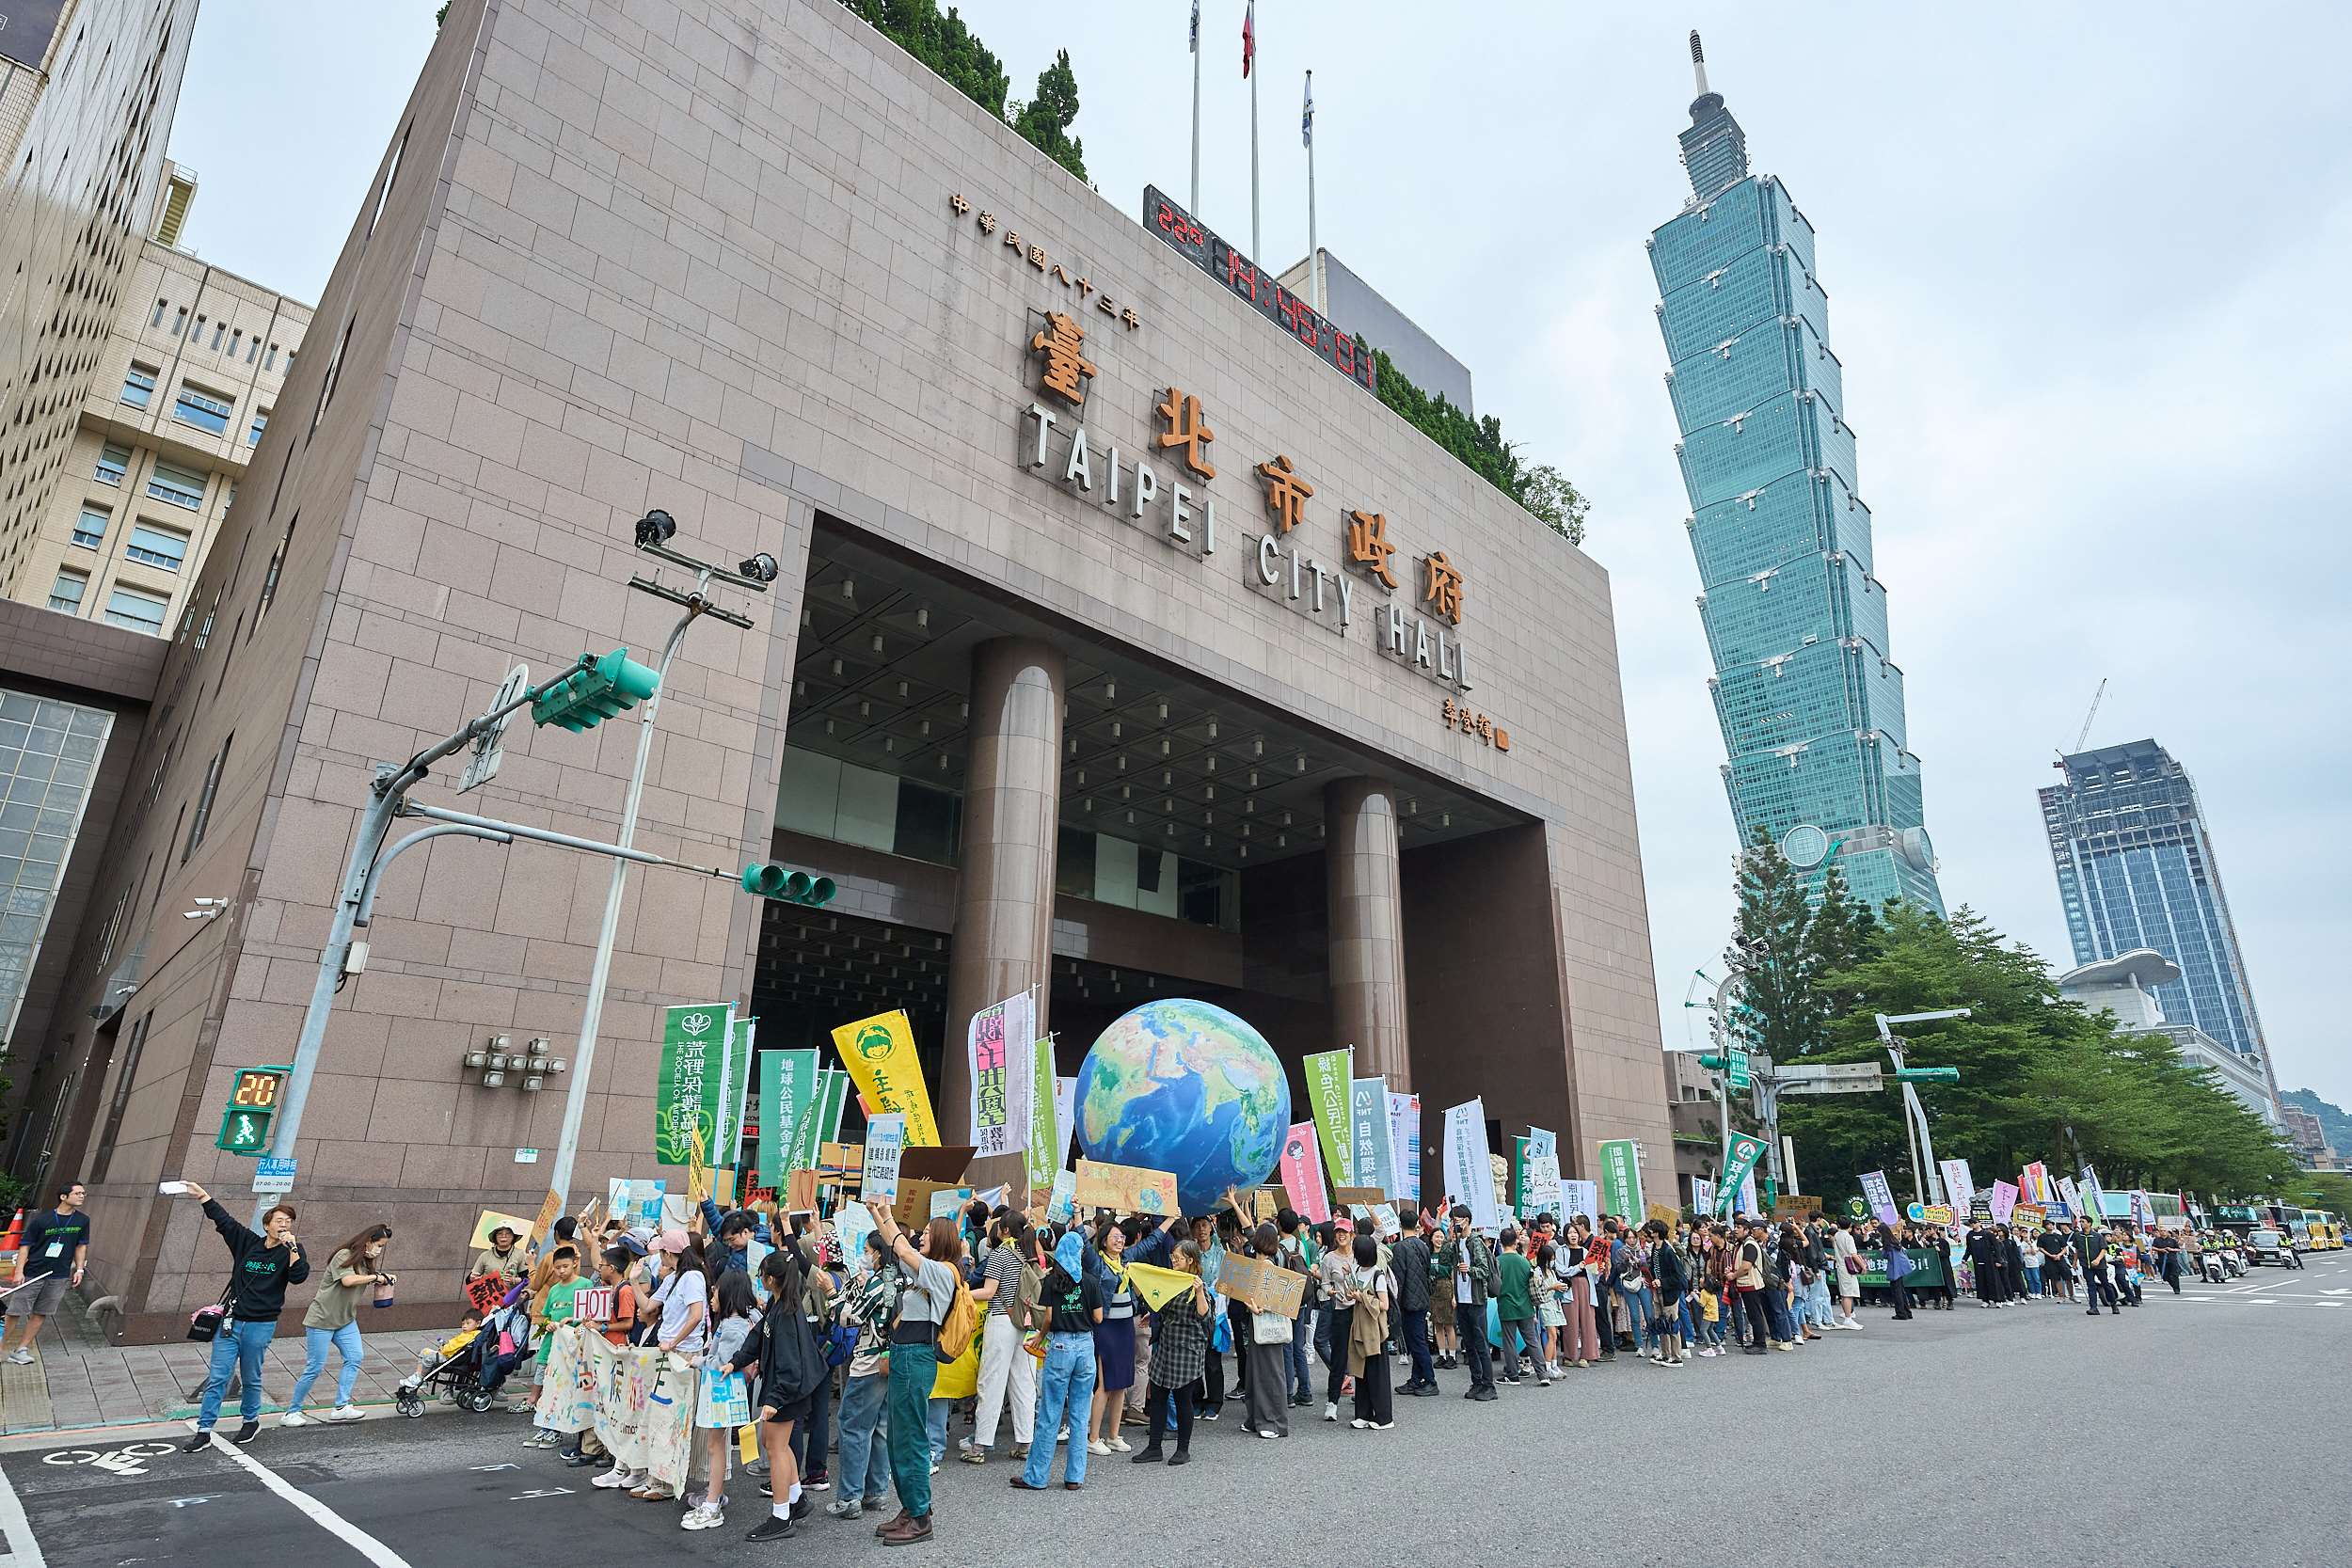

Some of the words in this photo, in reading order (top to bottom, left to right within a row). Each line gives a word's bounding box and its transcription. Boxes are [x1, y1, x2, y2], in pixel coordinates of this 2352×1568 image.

[950, 193, 1140, 331] 中華民國八十三年
[1031, 309, 1466, 626] 臺北市政府
[1031, 404, 1215, 557] TAIPEI
[1256, 534, 1354, 628] CITY
[1384, 603, 1474, 692] HALL
[235, 1074, 276, 1106] 20
[779, 1058, 795, 1159] 地球公民基金會
[576, 1290, 611, 1320] HOT
